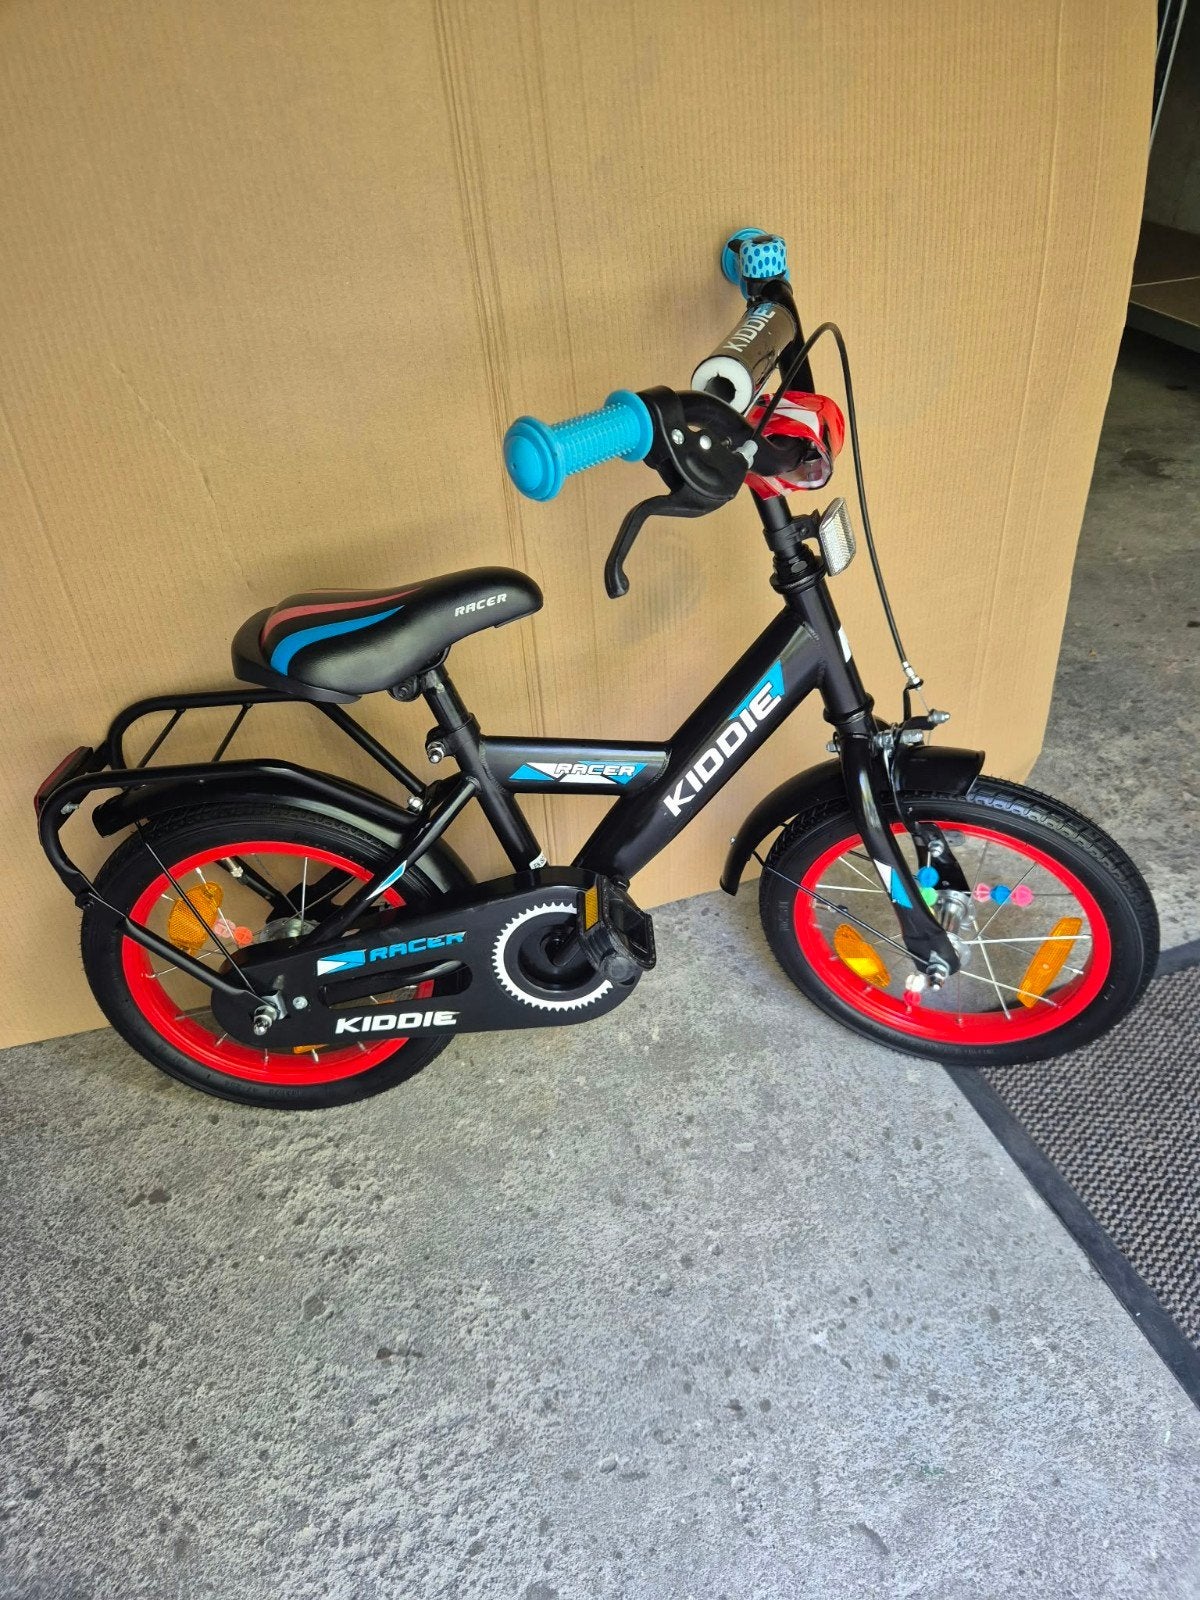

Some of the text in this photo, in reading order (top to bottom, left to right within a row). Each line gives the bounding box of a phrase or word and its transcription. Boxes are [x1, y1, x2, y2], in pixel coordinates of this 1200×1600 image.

[723, 306, 776, 353] KIDDIE
[454, 593, 507, 617] RACER
[663, 681, 782, 818] KIDDIE
[554, 762, 638, 777] RACER
[369, 931, 467, 963] RACER
[334, 1010, 461, 1034] KIDDIE
